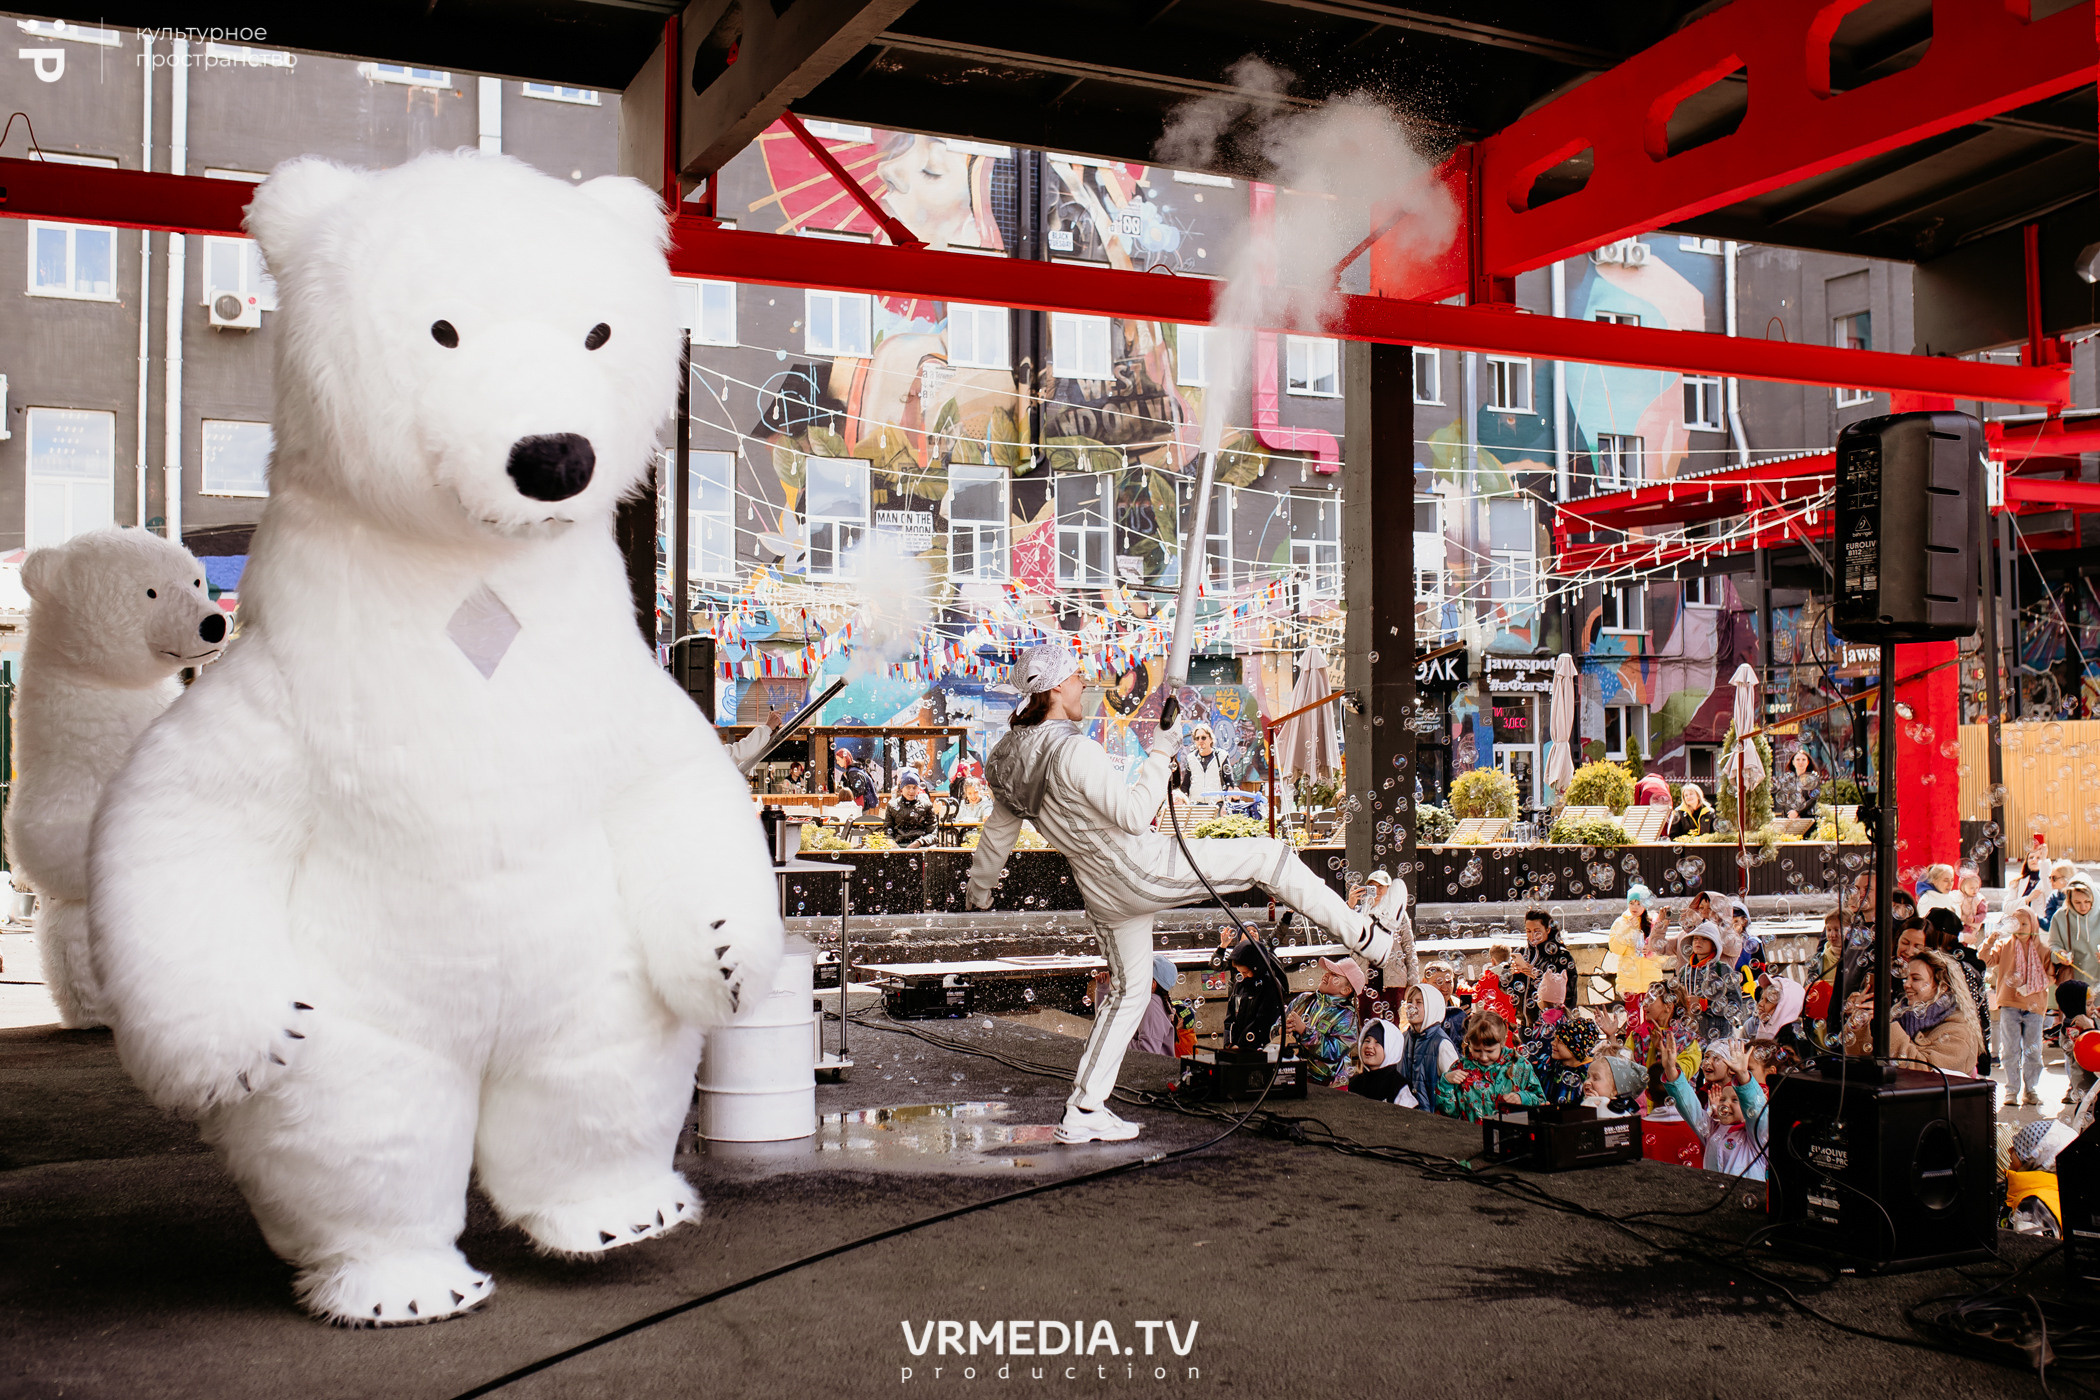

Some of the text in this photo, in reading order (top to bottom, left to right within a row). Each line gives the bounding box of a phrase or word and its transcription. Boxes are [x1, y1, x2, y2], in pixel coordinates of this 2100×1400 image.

[1051, 231, 1069, 240] BLACK
[877, 512, 931, 524] MAN ON THE
[1484, 655, 1557, 674] jawsspot
[1769, 703, 1793, 713] SPOT
